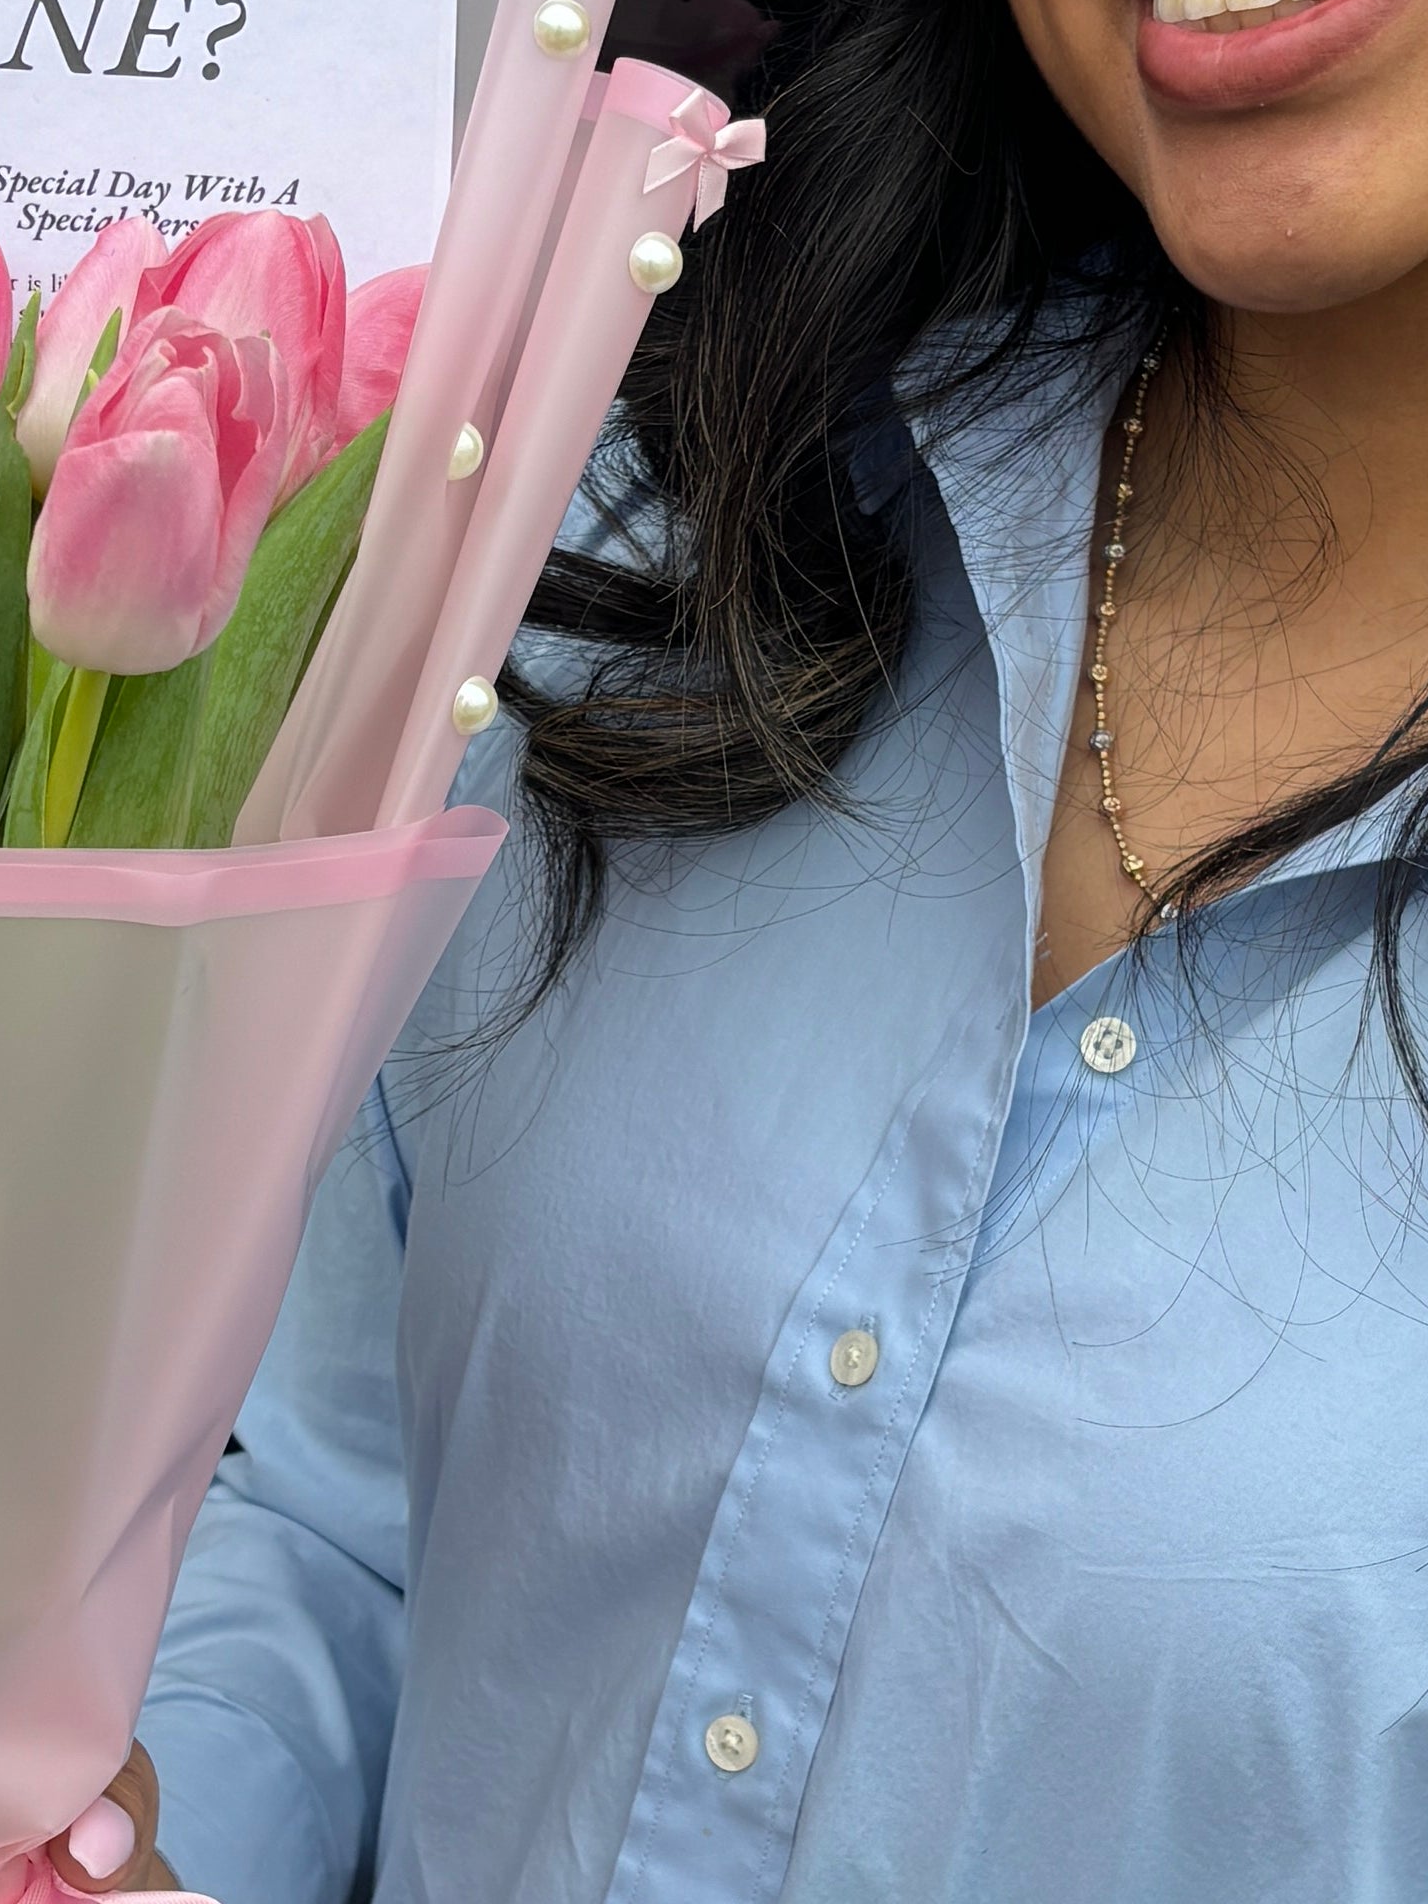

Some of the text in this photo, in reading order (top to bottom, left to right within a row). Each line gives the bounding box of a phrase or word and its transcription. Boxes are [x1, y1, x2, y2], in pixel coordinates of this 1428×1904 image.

[105, 170, 172, 208] Day
[183, 174, 266, 204] With
[273, 178, 301, 206] A
